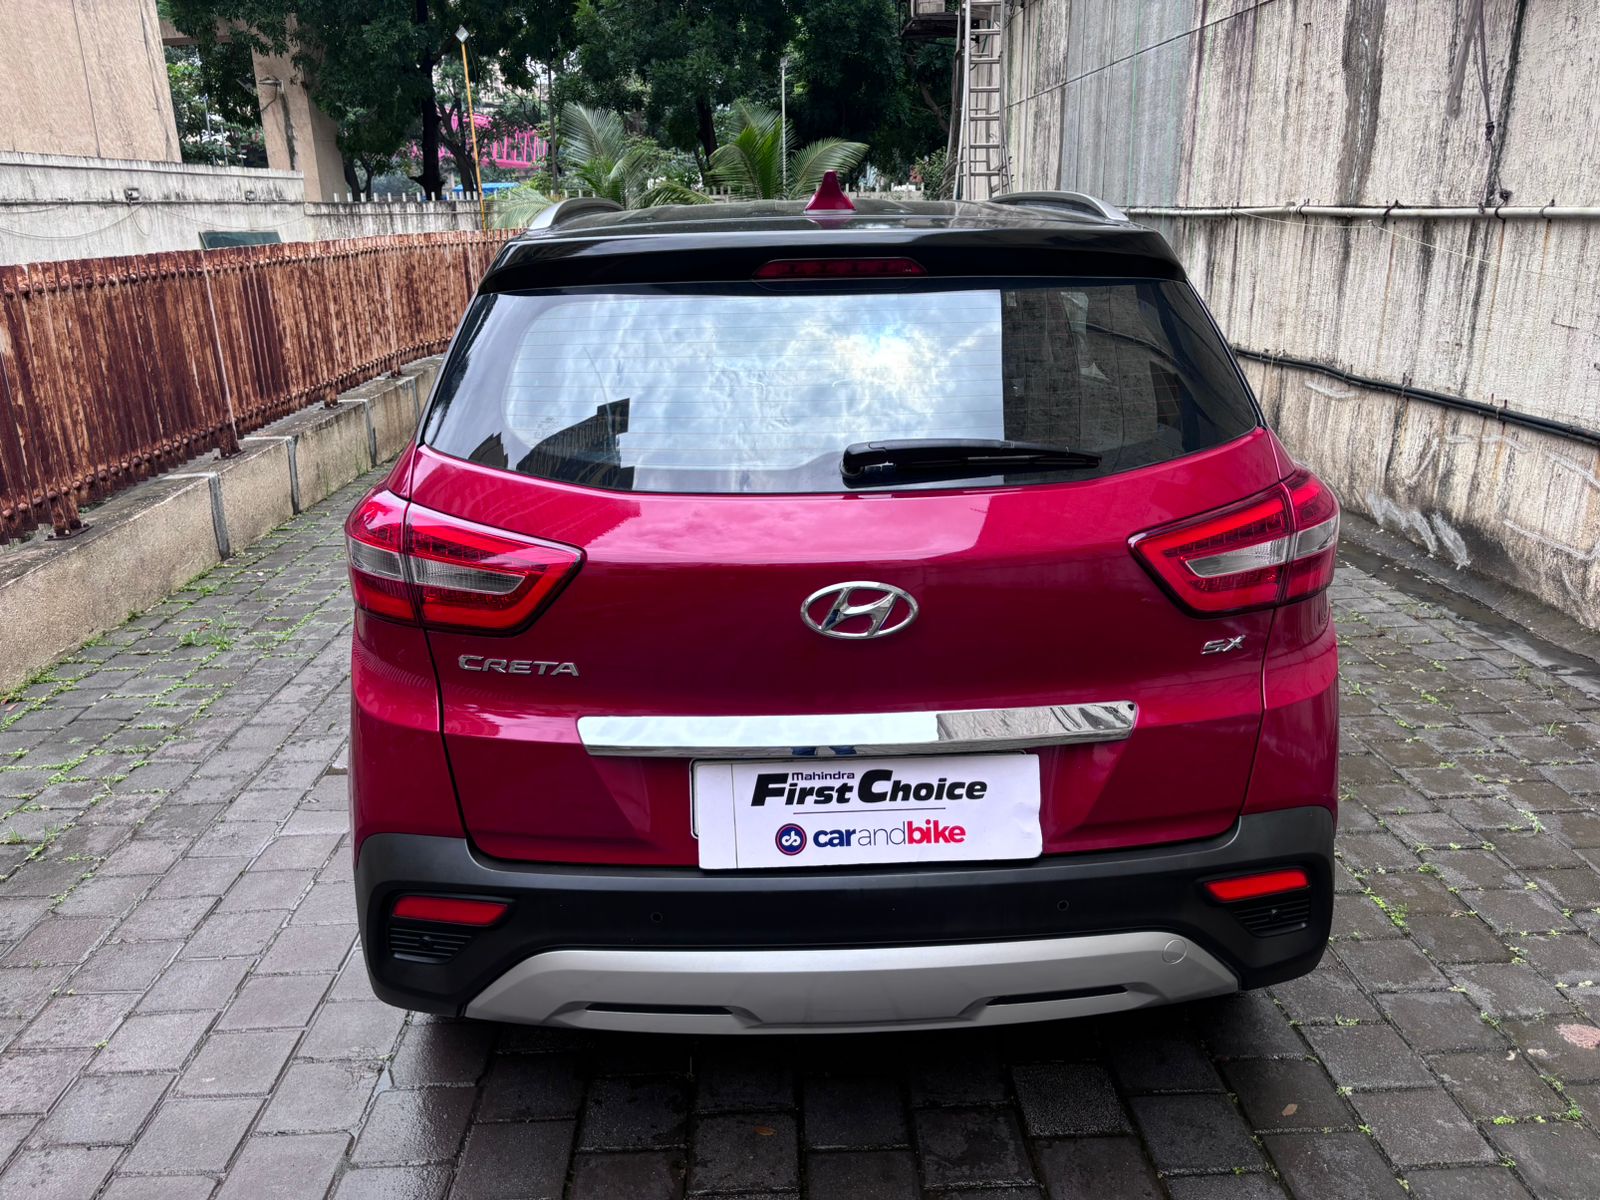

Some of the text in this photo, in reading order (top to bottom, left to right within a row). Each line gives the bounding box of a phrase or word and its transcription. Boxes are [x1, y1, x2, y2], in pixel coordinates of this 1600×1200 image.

[1201, 634, 1246, 655] SX
[458, 654, 579, 676] CRETA
[791, 771, 855, 781] Mahindra
[750, 769, 987, 806] First Choice
[812, 819, 966, 848] carandbike
